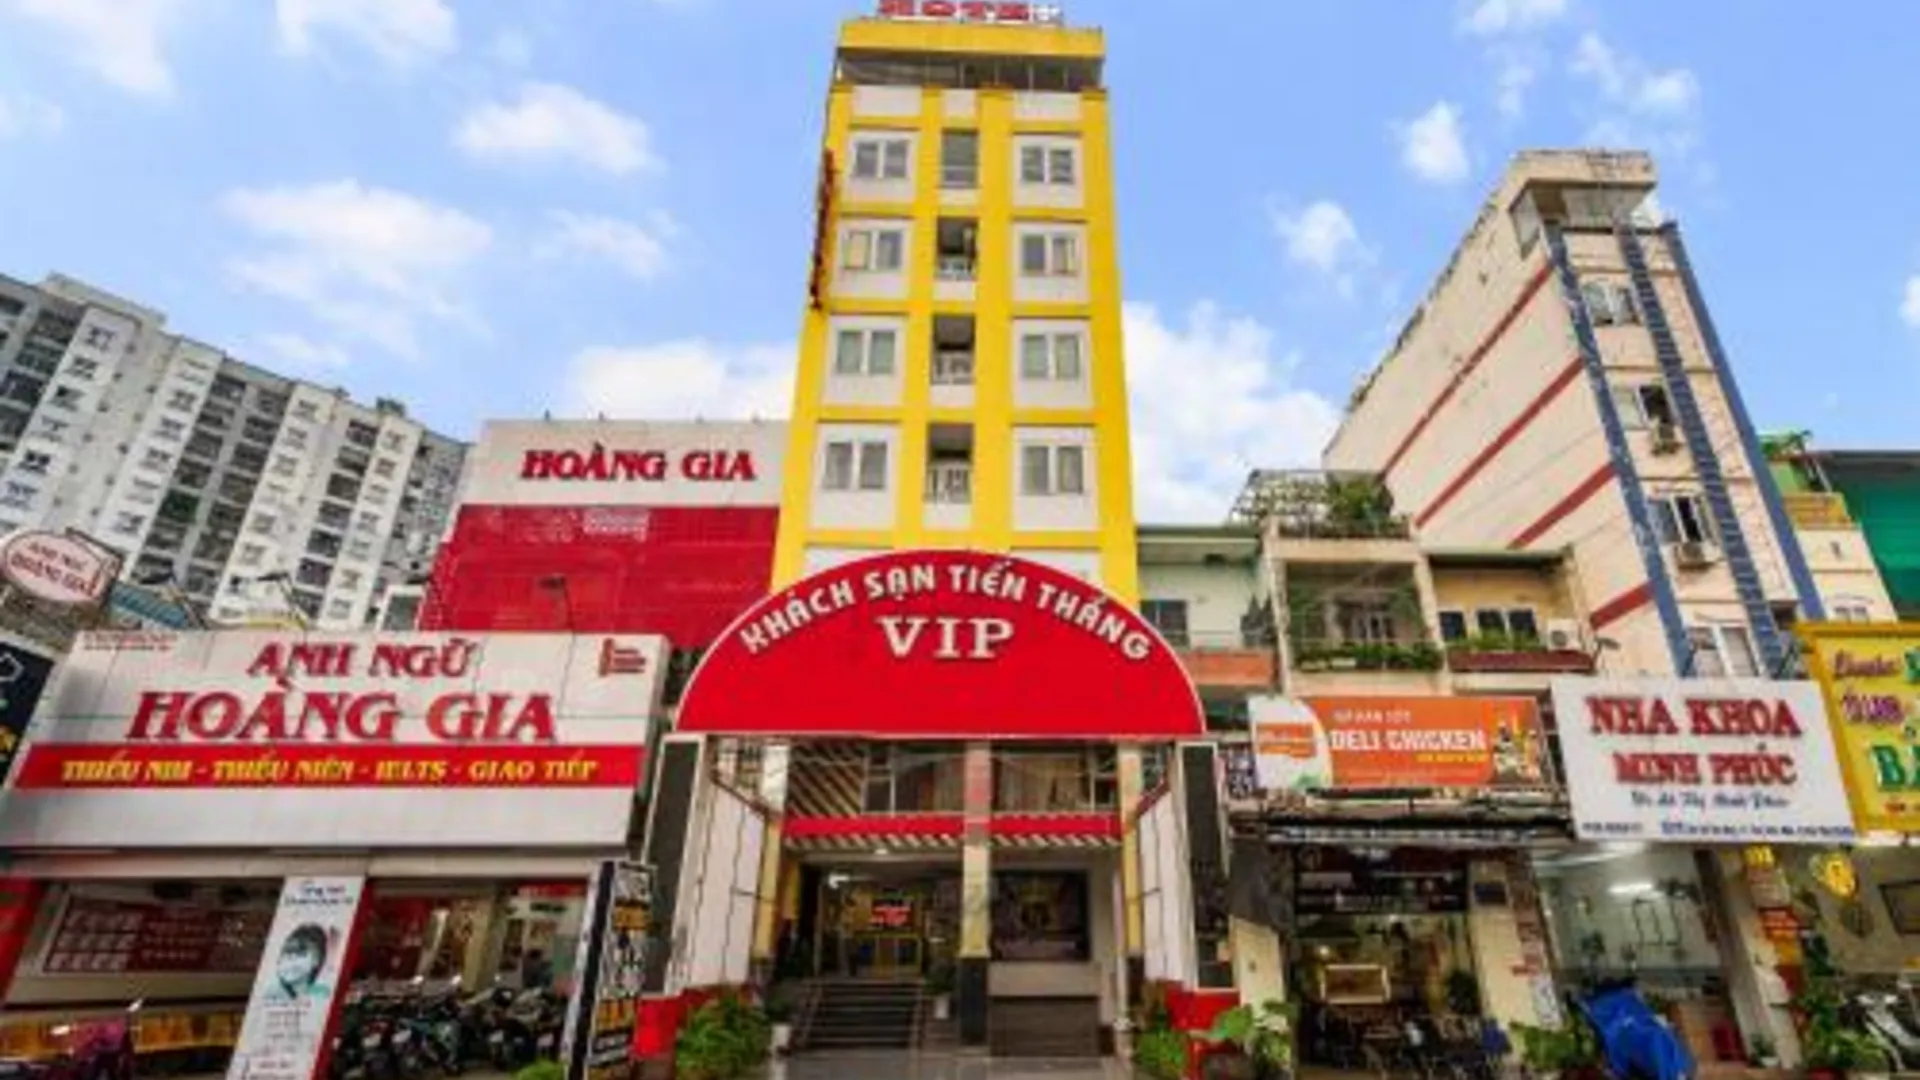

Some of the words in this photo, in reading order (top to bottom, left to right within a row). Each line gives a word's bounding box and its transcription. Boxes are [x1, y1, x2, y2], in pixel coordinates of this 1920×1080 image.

[521, 442, 667, 481] HOÀNG
[681, 451, 756, 481] GIA
[740, 578, 856, 654] KHÁCH
[864, 564, 935, 601] SẠN
[247, 642, 356, 677] ANH
[368, 638, 479, 678] NGỮ
[876, 614, 1014, 660] VIP
[126, 677, 403, 741] HOÀNG
[426, 693, 557, 741] GIA
[1585, 696, 1679, 735] NHA
[1684, 696, 1804, 738] KHOA
[1330, 729, 1380, 751] DELI
[1385, 728, 1488, 751] CHICKEN
[375, 759, 449, 781] IELTS
[467, 759, 536, 781] GIAO
[544, 748, 598, 781] TIẾP
[1612, 751, 1703, 785] MINH
[1708, 742, 1798, 785] PHÚC
